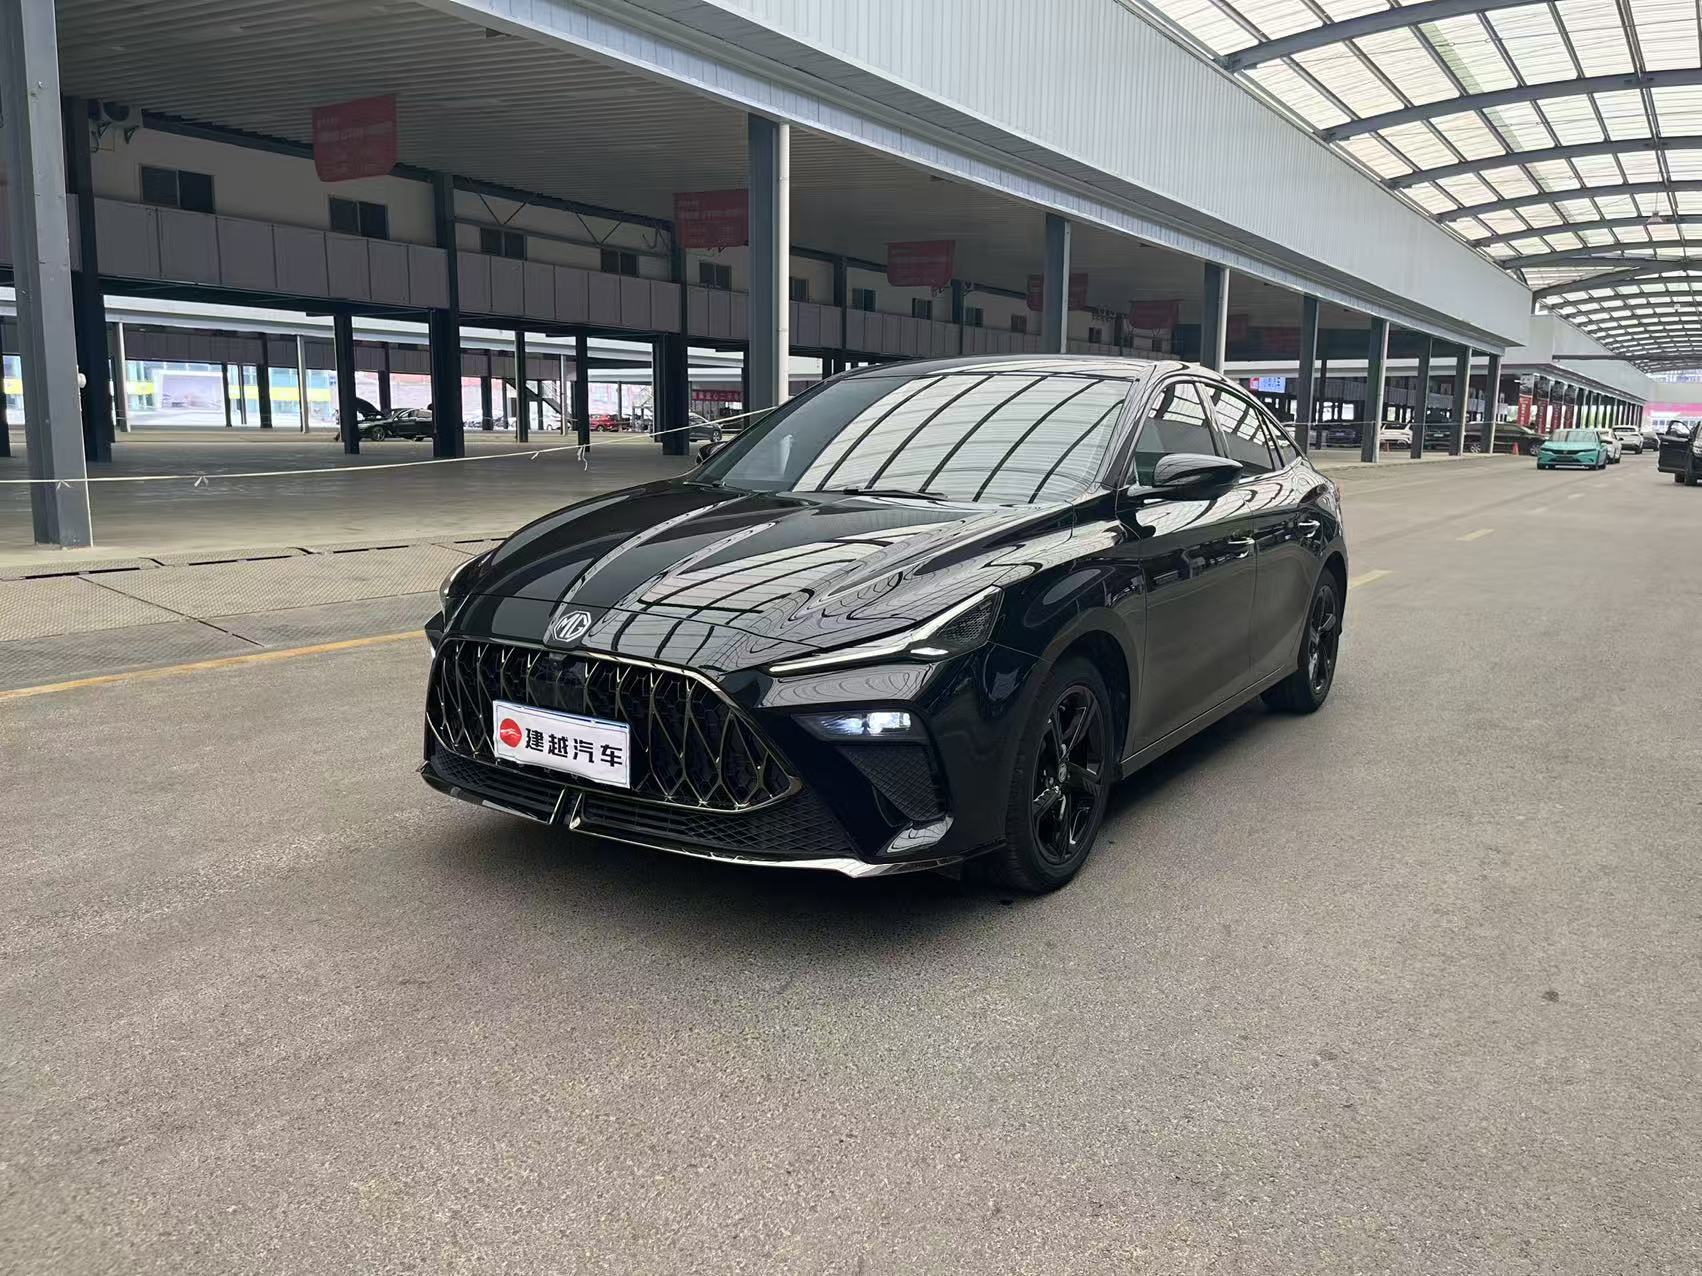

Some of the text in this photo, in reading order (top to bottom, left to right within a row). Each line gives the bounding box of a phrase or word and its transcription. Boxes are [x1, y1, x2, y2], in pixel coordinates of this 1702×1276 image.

[555, 612, 589, 640] MG
[525, 728, 623, 767] 建越汽车
